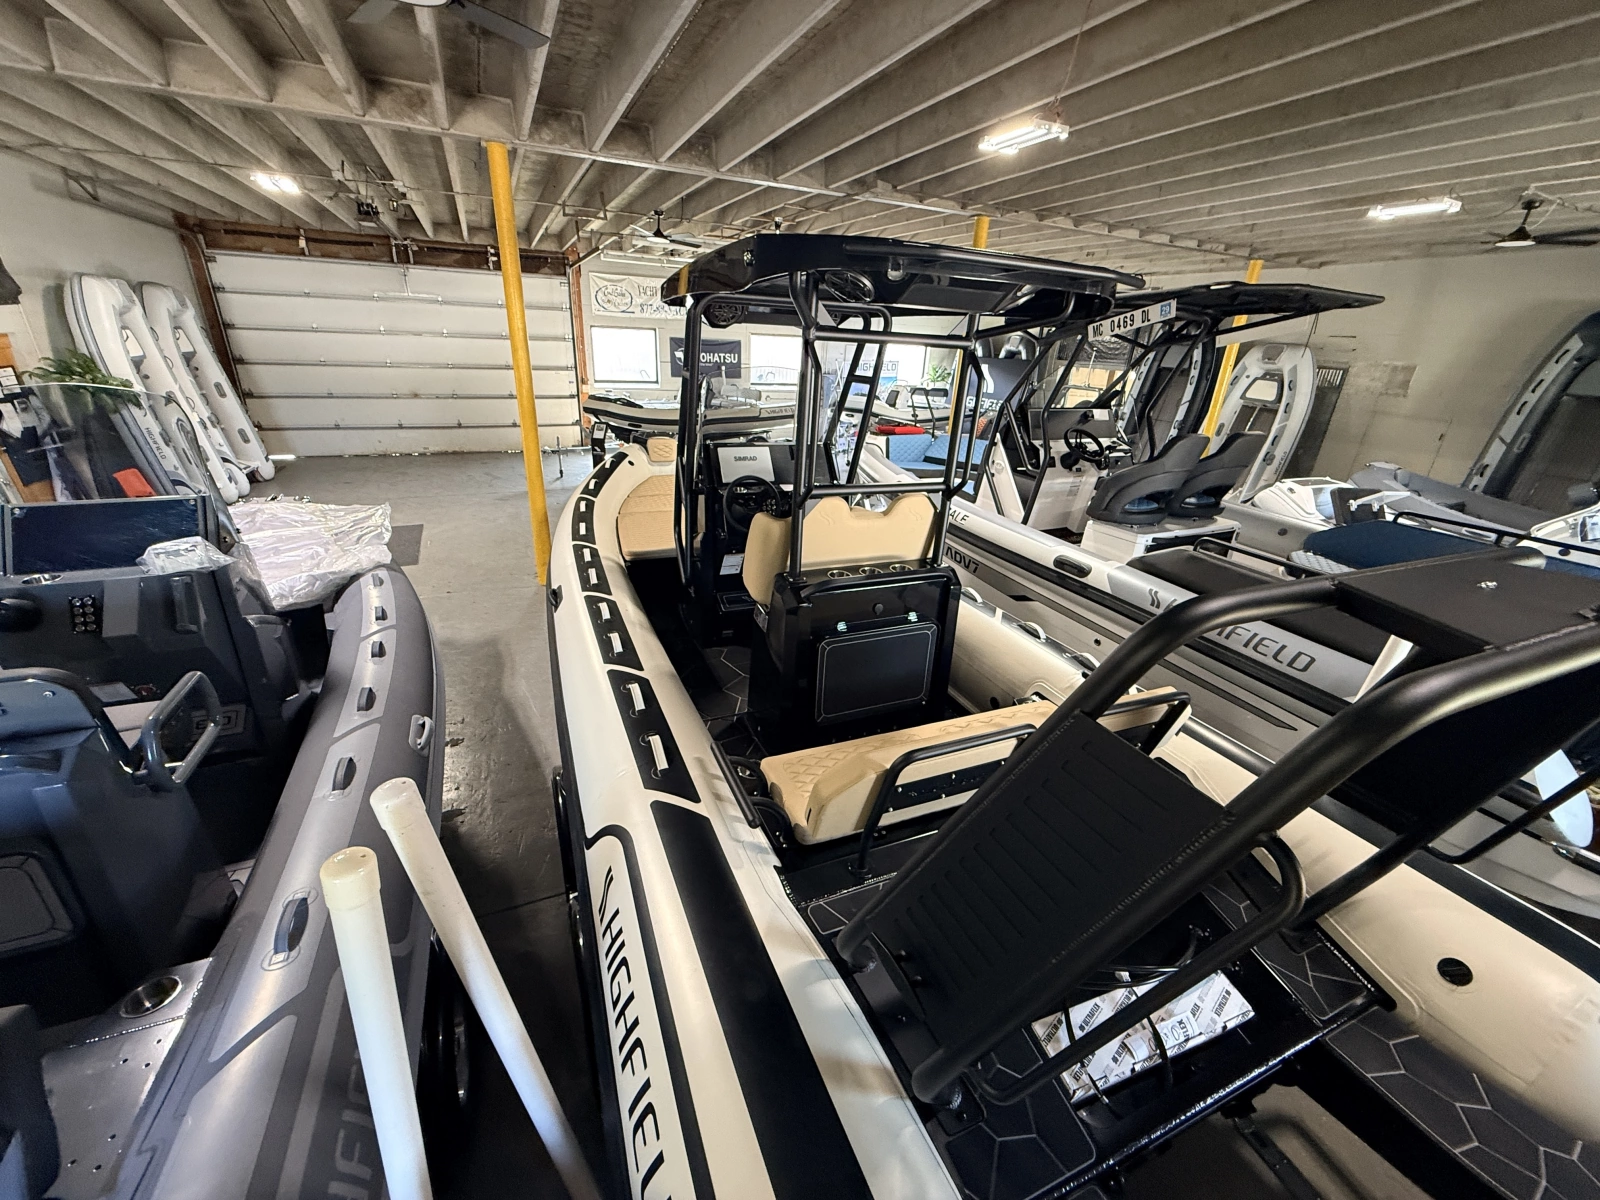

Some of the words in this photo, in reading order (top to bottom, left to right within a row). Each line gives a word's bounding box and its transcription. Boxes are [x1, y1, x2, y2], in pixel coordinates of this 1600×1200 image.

[1161, 306, 1170, 315] 29
[1092, 323, 1104, 338] MC
[1110, 313, 1135, 332] 0469
[1141, 309, 1151, 323] DL
[700, 353, 738, 363] OHATSU
[949, 509, 970, 525] ALE
[1082, 1002, 1101, 1027] ULTRAFLEX
[602, 907, 672, 1200] HIGHFIEL
